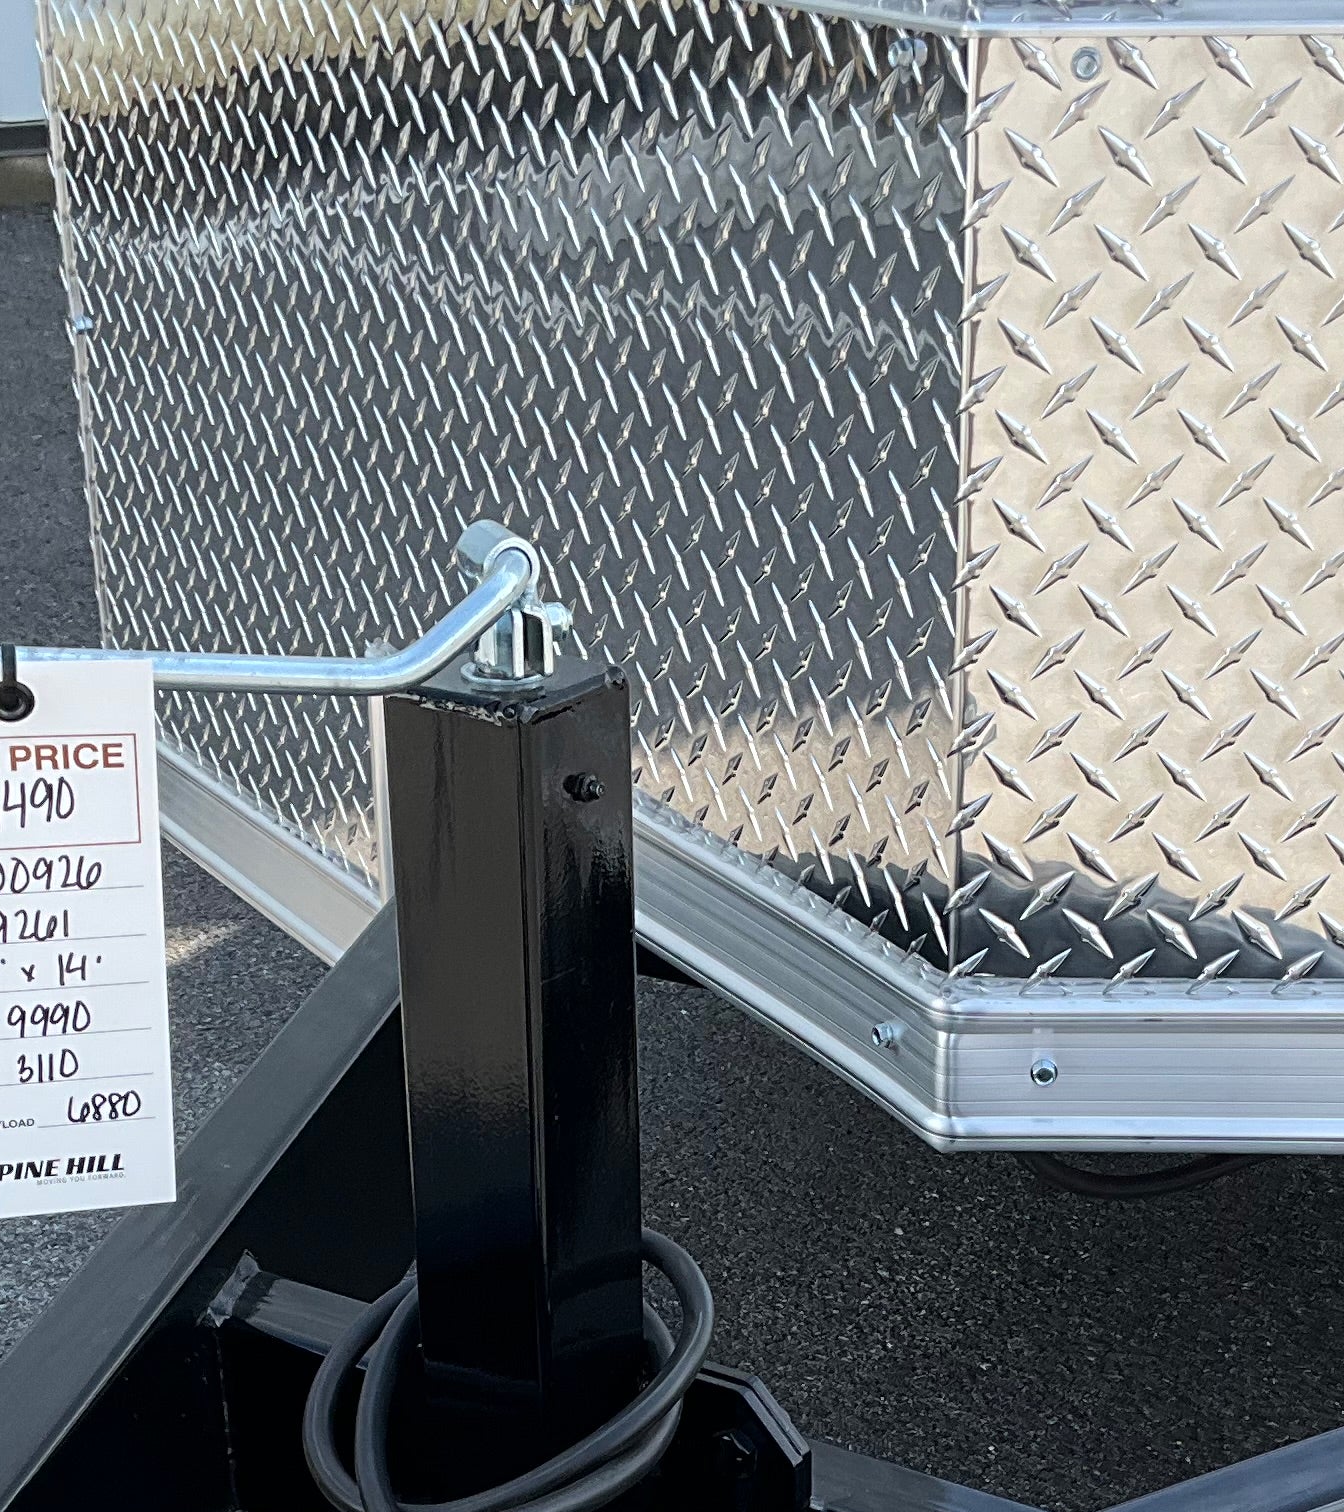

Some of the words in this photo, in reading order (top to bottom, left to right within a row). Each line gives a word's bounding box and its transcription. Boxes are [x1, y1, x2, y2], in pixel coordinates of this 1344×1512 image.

[9, 742, 125, 772] PRICE
[7, 1000, 91, 1038] 9990
[17, 1048, 79, 1084] 3110
[67, 1090, 141, 1123] 6880
[66, 1153, 125, 1175] HILL
